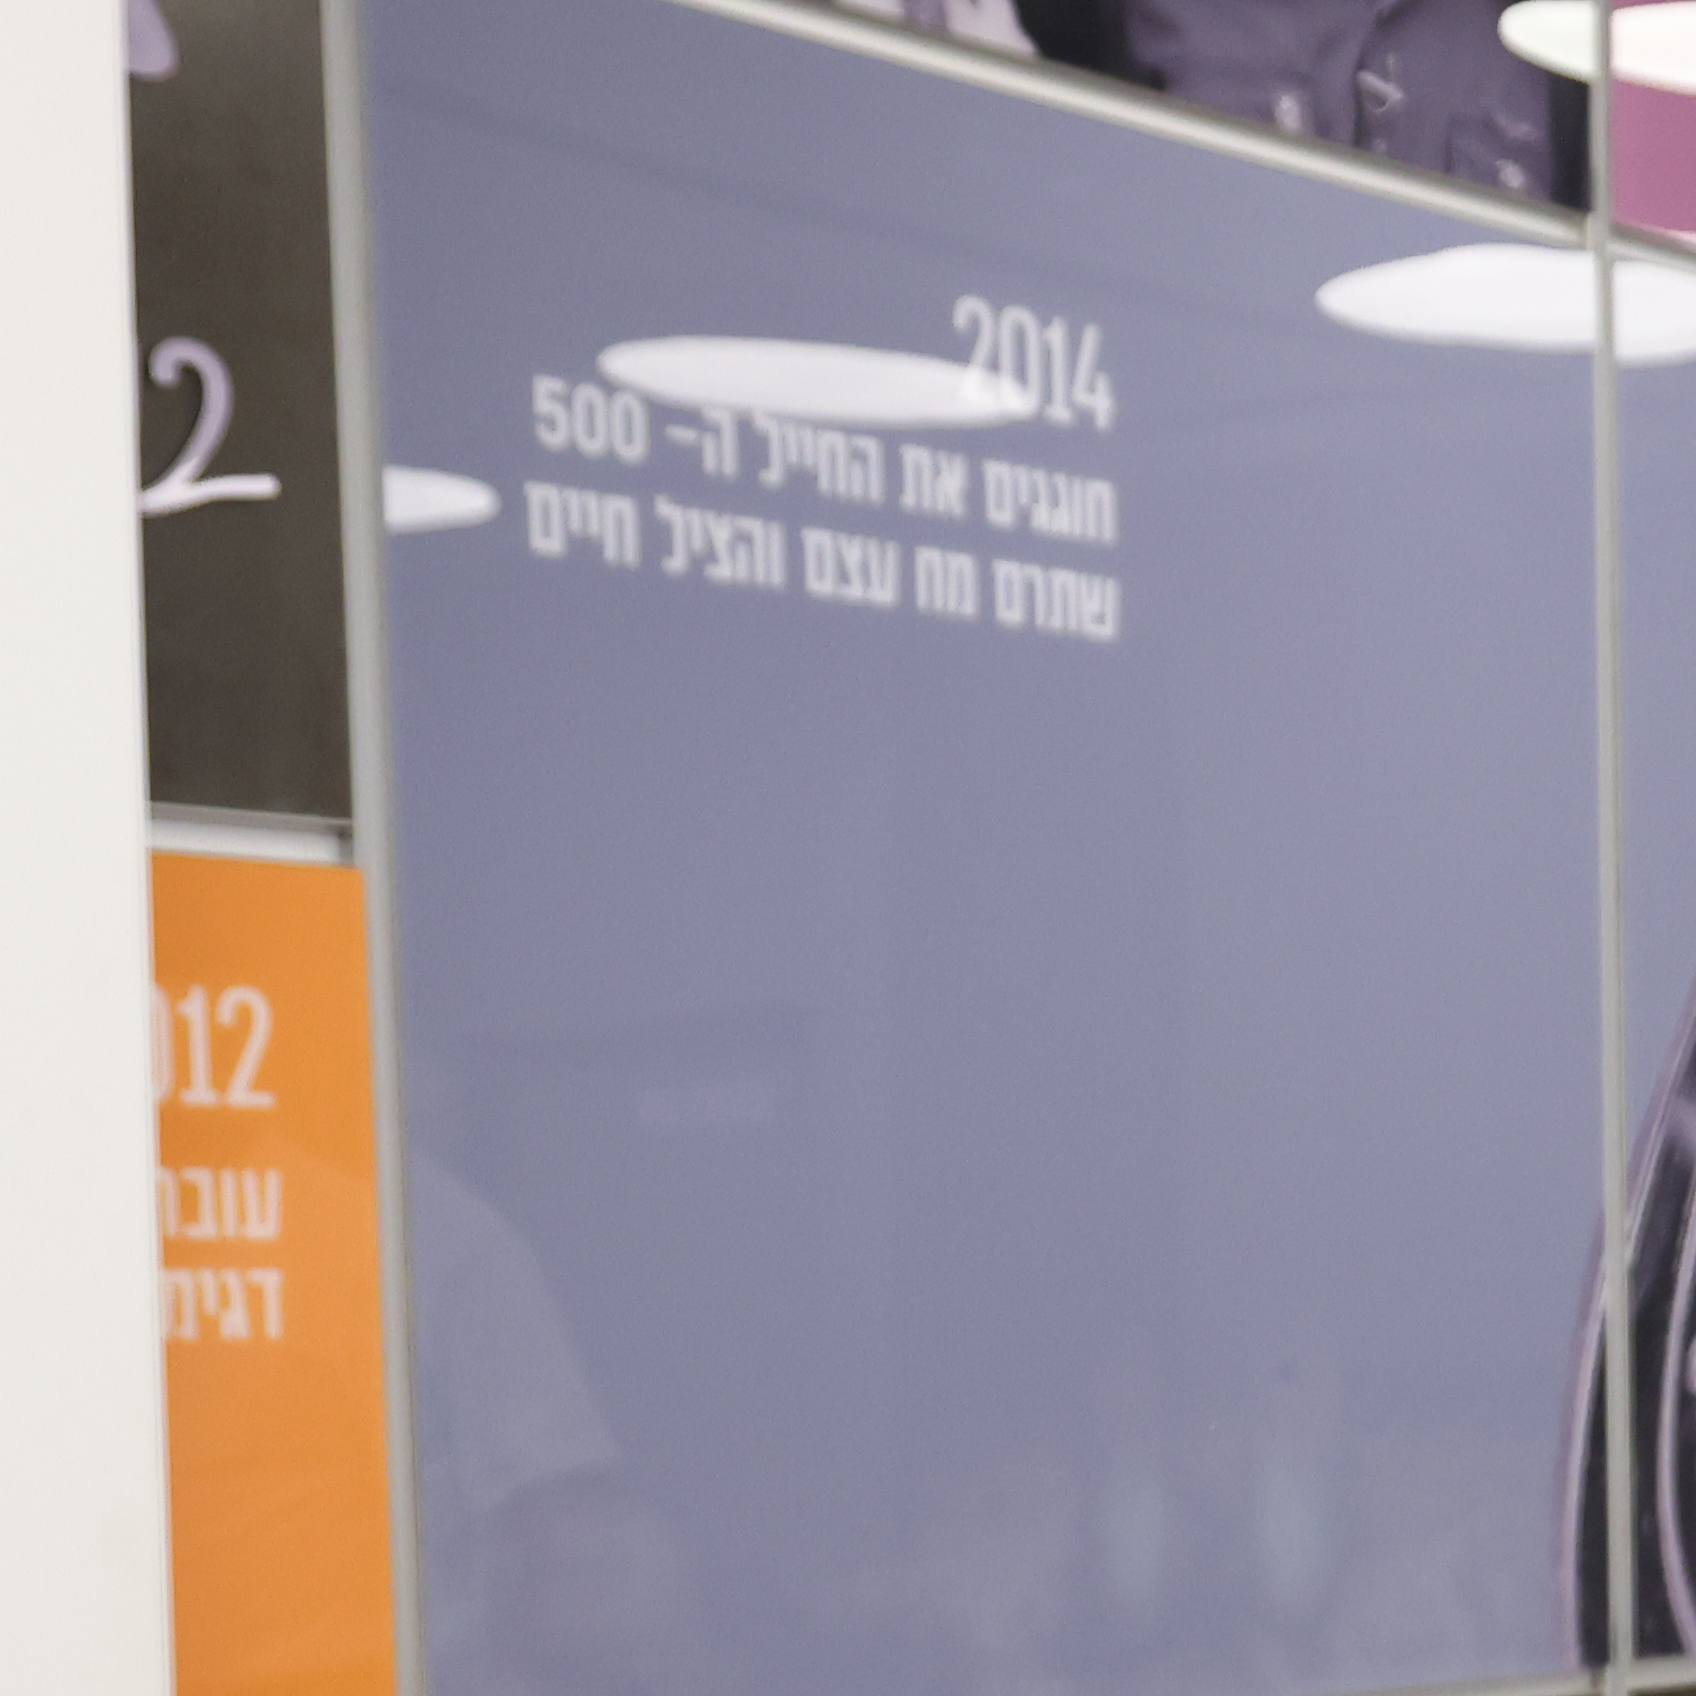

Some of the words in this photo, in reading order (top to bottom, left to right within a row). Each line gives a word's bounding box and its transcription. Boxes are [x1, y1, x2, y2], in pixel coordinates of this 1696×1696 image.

[958, 298, 1112, 429] 2014
[535, 378, 645, 460] 500
[756, 418, 882, 503] החייל
[903, 447, 966, 516] את
[987, 461, 1113, 541] חוגגים
[527, 484, 639, 566] חיים
[658, 497, 783, 589] והציל
[805, 531, 896, 605] עצם
[918, 549, 976, 617] מח
[993, 561, 1116, 639] שתרם
